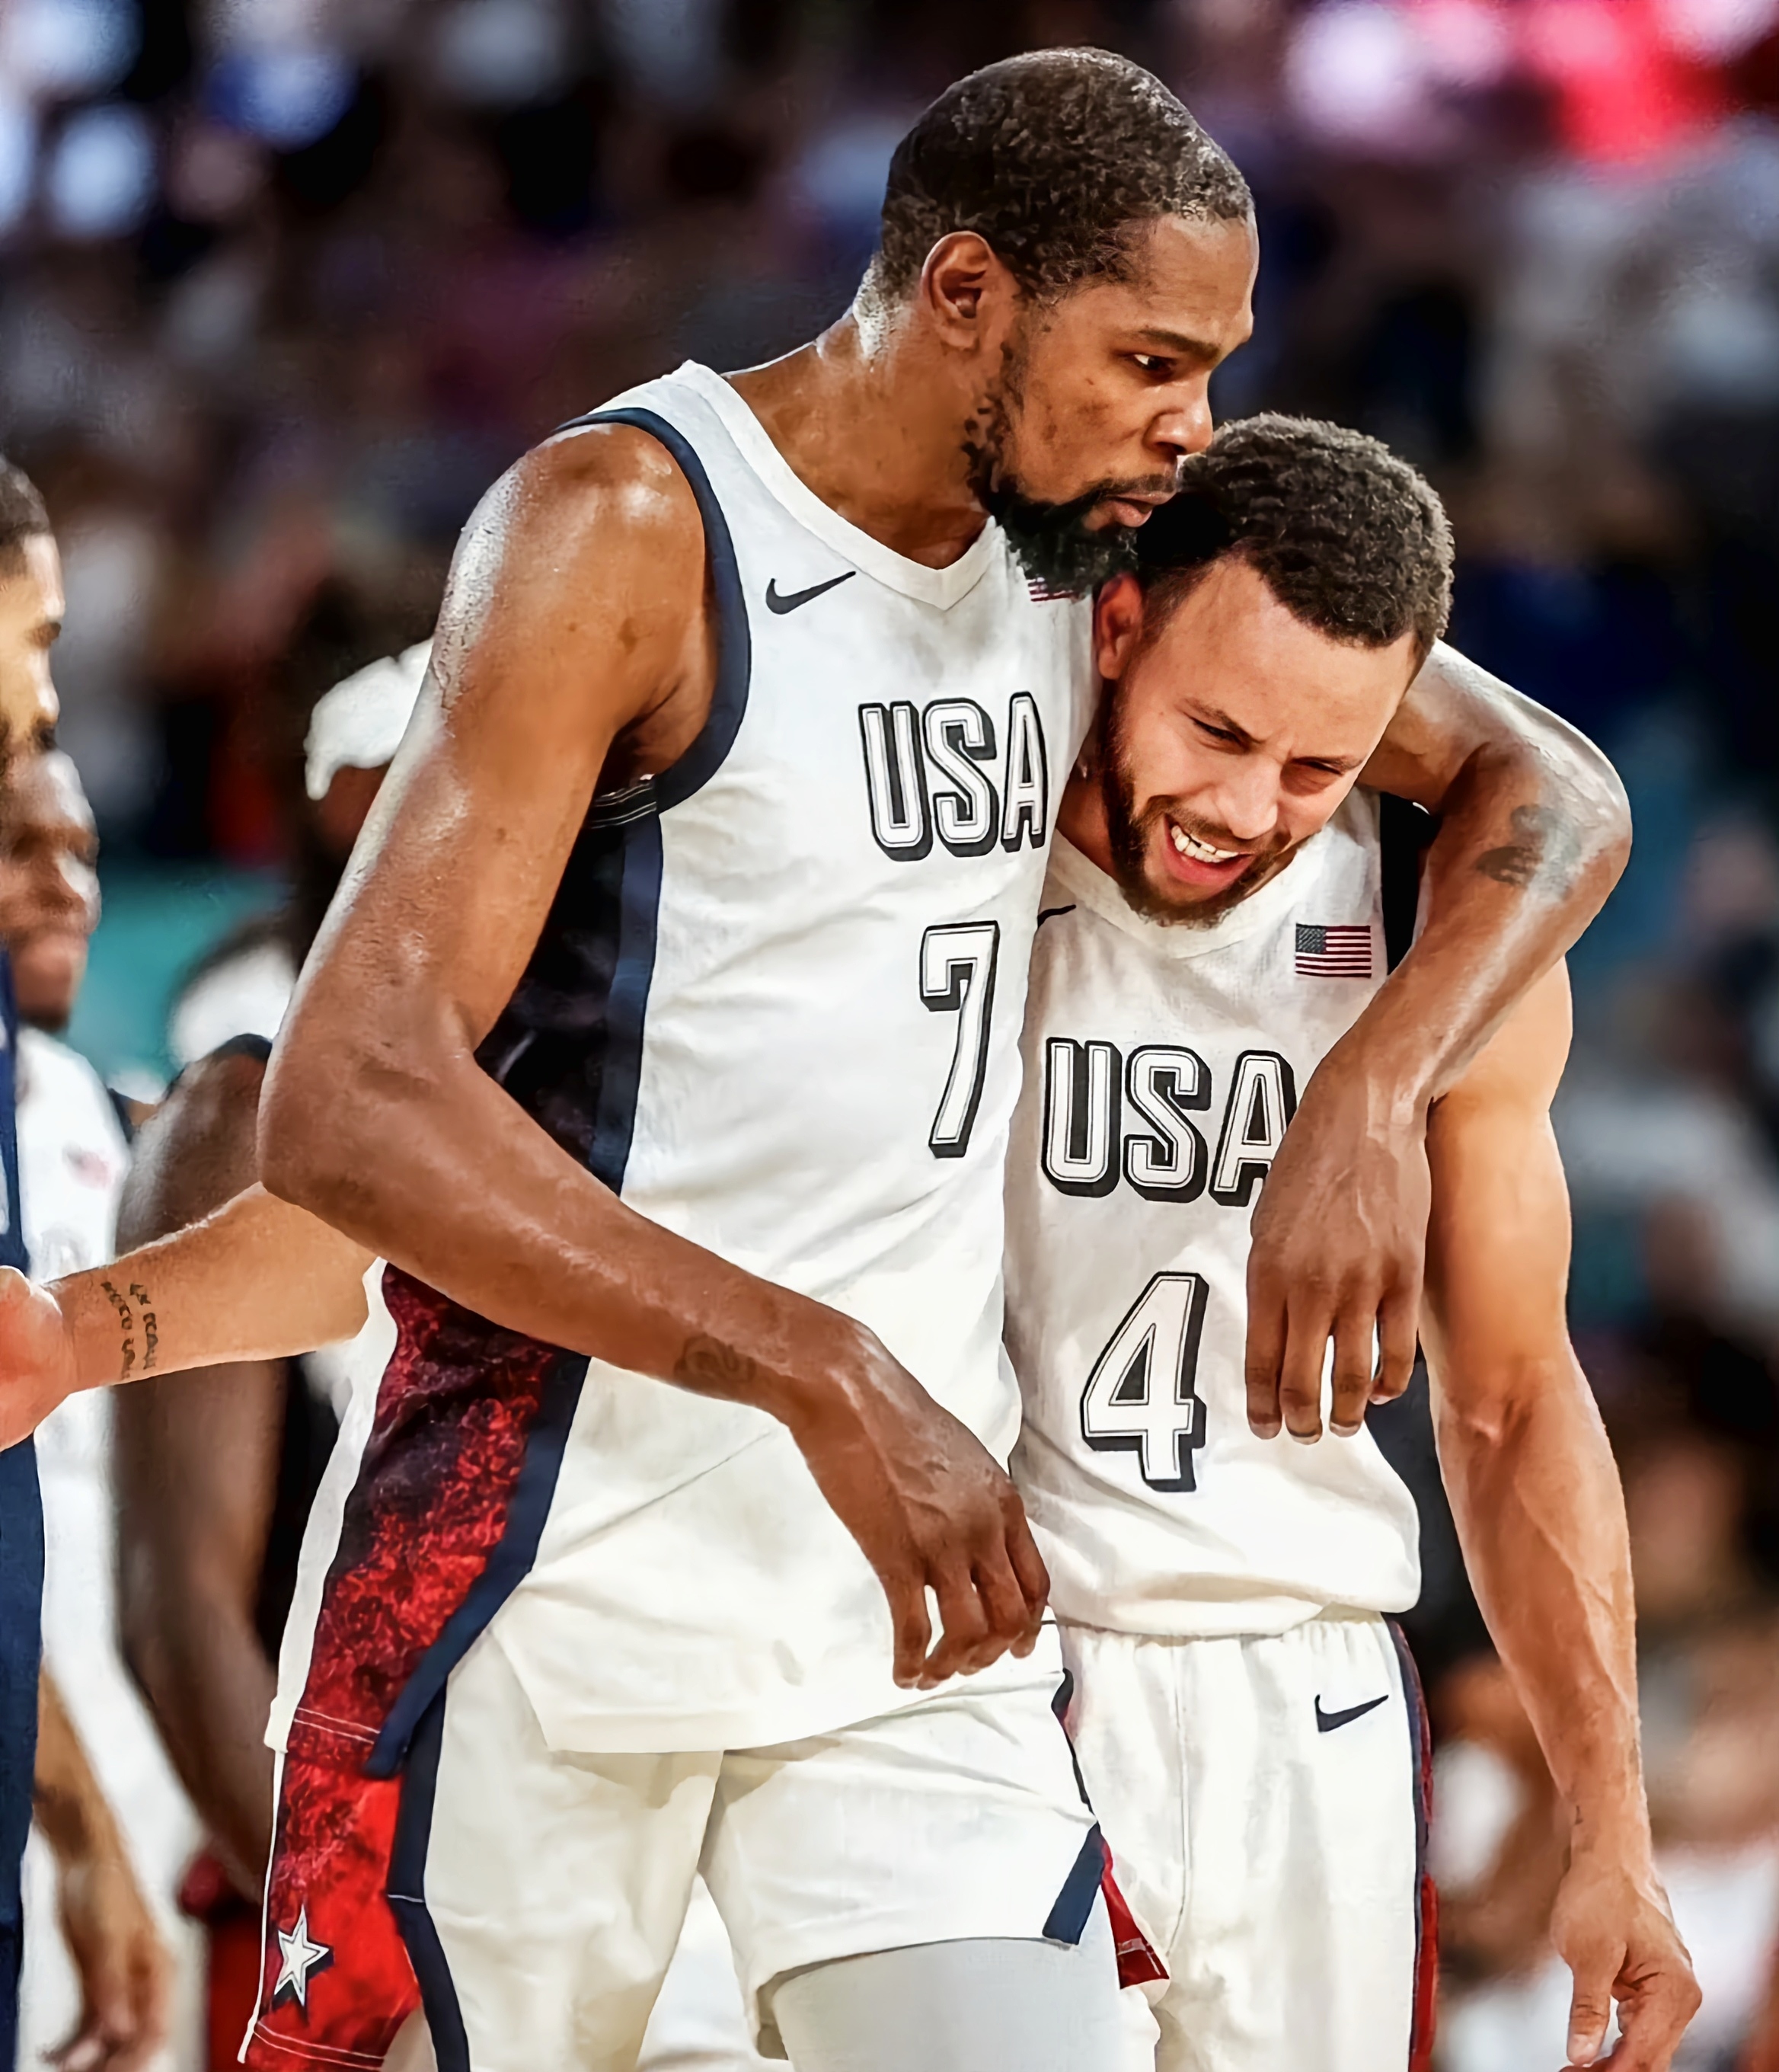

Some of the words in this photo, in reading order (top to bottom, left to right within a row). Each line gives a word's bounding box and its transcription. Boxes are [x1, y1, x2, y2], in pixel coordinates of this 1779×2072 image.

[858, 690, 1049, 862] USA
[919, 920, 1000, 1159] 7
[1041, 1036, 1297, 1207] USA
[1079, 1271, 1209, 1492] 4
